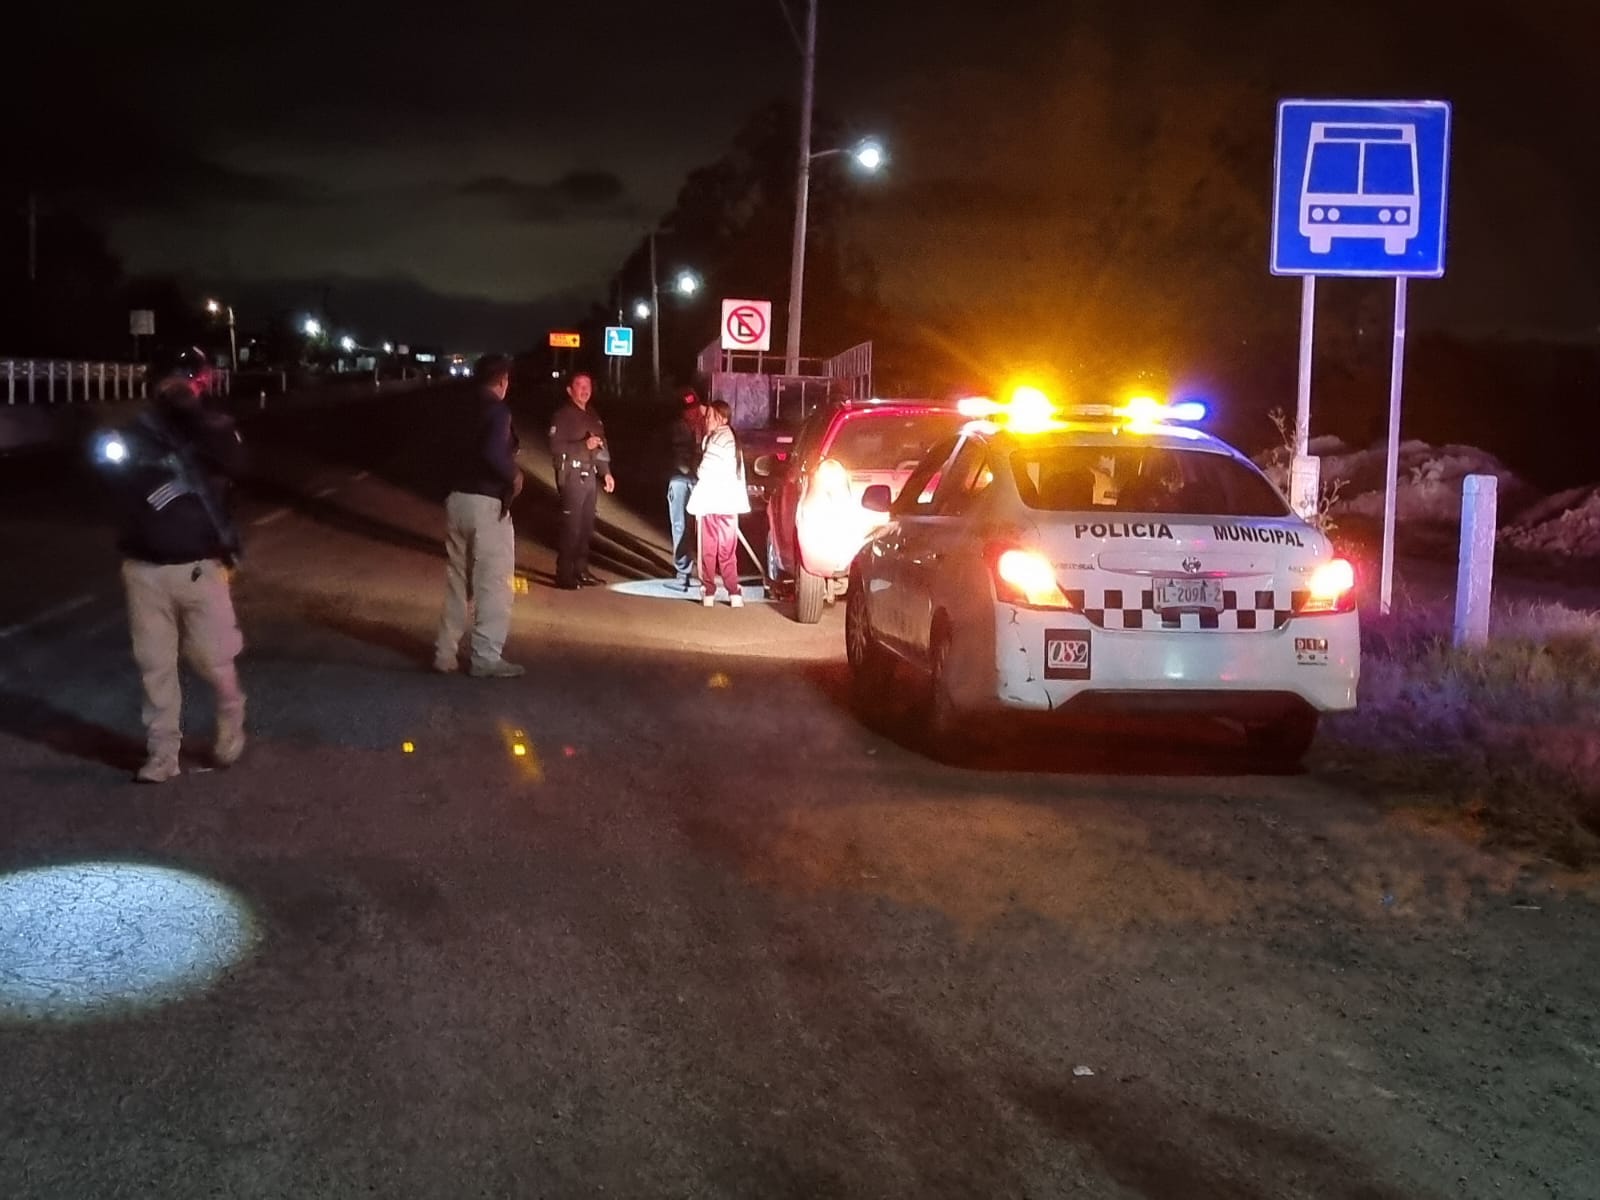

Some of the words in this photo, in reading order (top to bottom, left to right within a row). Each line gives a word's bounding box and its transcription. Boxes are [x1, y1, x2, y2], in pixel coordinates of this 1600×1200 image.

[1074, 522, 1174, 540] POLICIA
[1212, 524, 1304, 548] MUNICIPAL
[1049, 641, 1088, 663] 089
